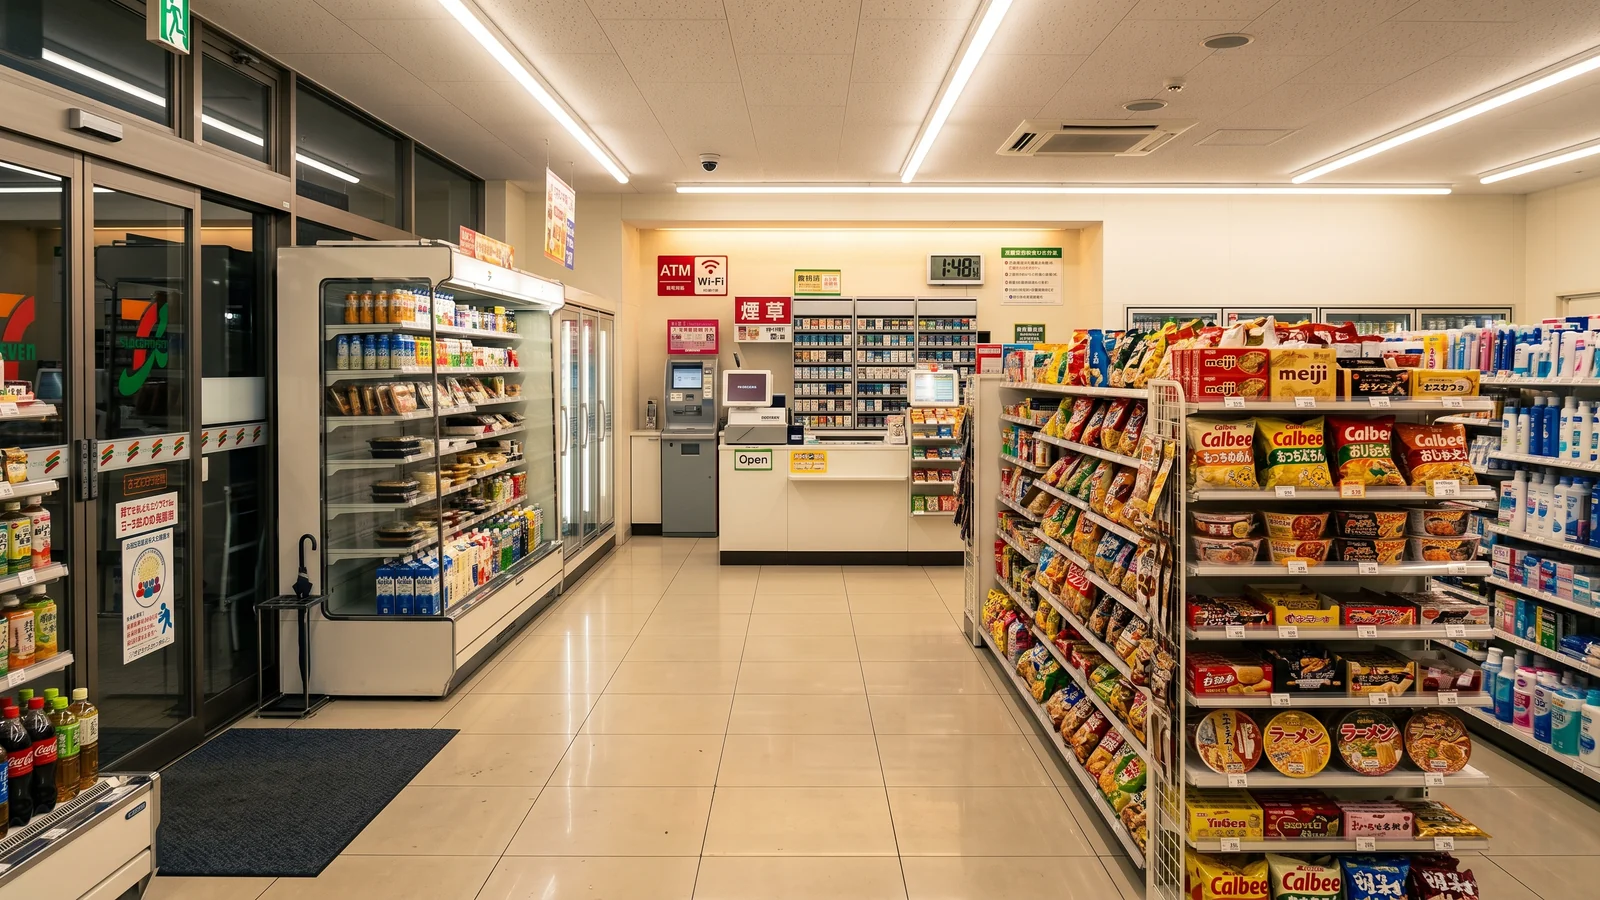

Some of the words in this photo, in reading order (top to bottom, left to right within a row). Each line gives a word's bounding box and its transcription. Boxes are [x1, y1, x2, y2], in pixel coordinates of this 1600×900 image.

[660, 264, 691, 277] ATM
[942, 257, 972, 278] 1:48
[697, 277, 725, 286] Wi-Fi
[740, 301, 785, 321] 煙草
[1205, 355, 1237, 370] meiji
[1279, 364, 1328, 385] meiji
[1205, 381, 1237, 397] meiji
[1201, 431, 1252, 448] Calbee
[1273, 430, 1323, 447] Calbee
[1414, 433, 1464, 447] Calbee
[739, 454, 768, 466] Open
[1269, 726, 1323, 745] ラーメン
[1341, 723, 1396, 741] ラーメン
[1410, 723, 1463, 742] ラーメン
[1211, 876, 1268, 896] Calbee
[1282, 872, 1340, 892] Calbee
